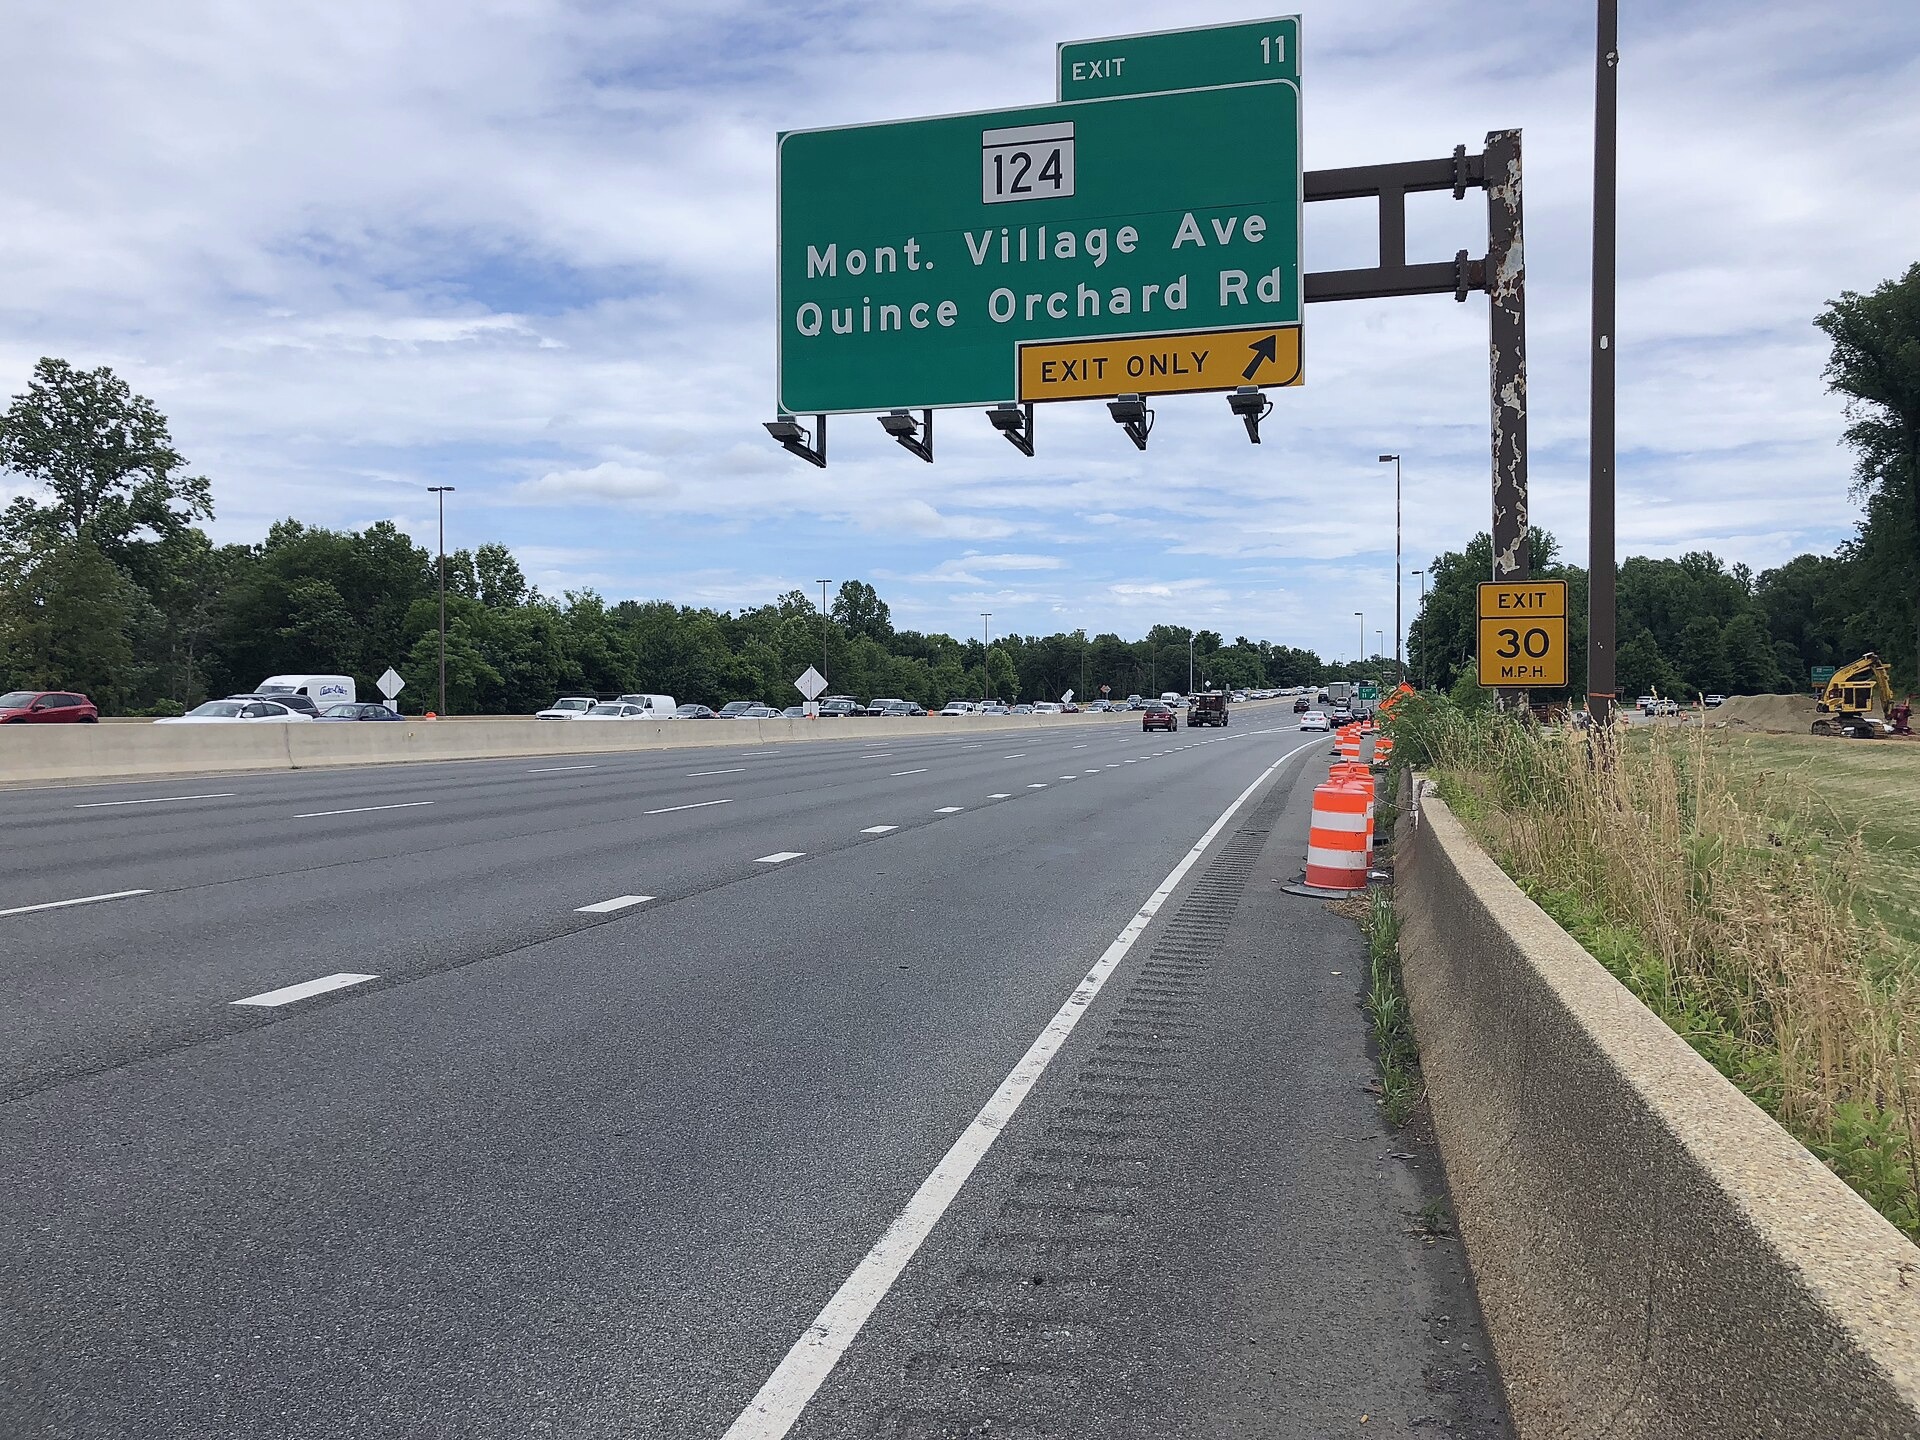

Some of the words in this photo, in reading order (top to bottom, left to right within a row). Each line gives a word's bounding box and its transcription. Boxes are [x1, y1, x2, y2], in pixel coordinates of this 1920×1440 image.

[1072, 57, 1126, 81] EXIT
[1260, 35, 1285, 64] 11
[993, 148, 1063, 196] 124
[807, 237, 934, 279] Mont.
[963, 225, 1139, 268] Village
[1171, 212, 1267, 249] Ave
[796, 296, 958, 337] Quince
[988, 274, 1187, 323] Orchard
[1219, 266, 1281, 306] Rd
[1041, 357, 1108, 383] EXIT
[1126, 350, 1209, 378] ONLY
[1498, 592, 1547, 609] EXIT
[1496, 628, 1550, 658] 30
[1501, 665, 1547, 678] M.P.H.
